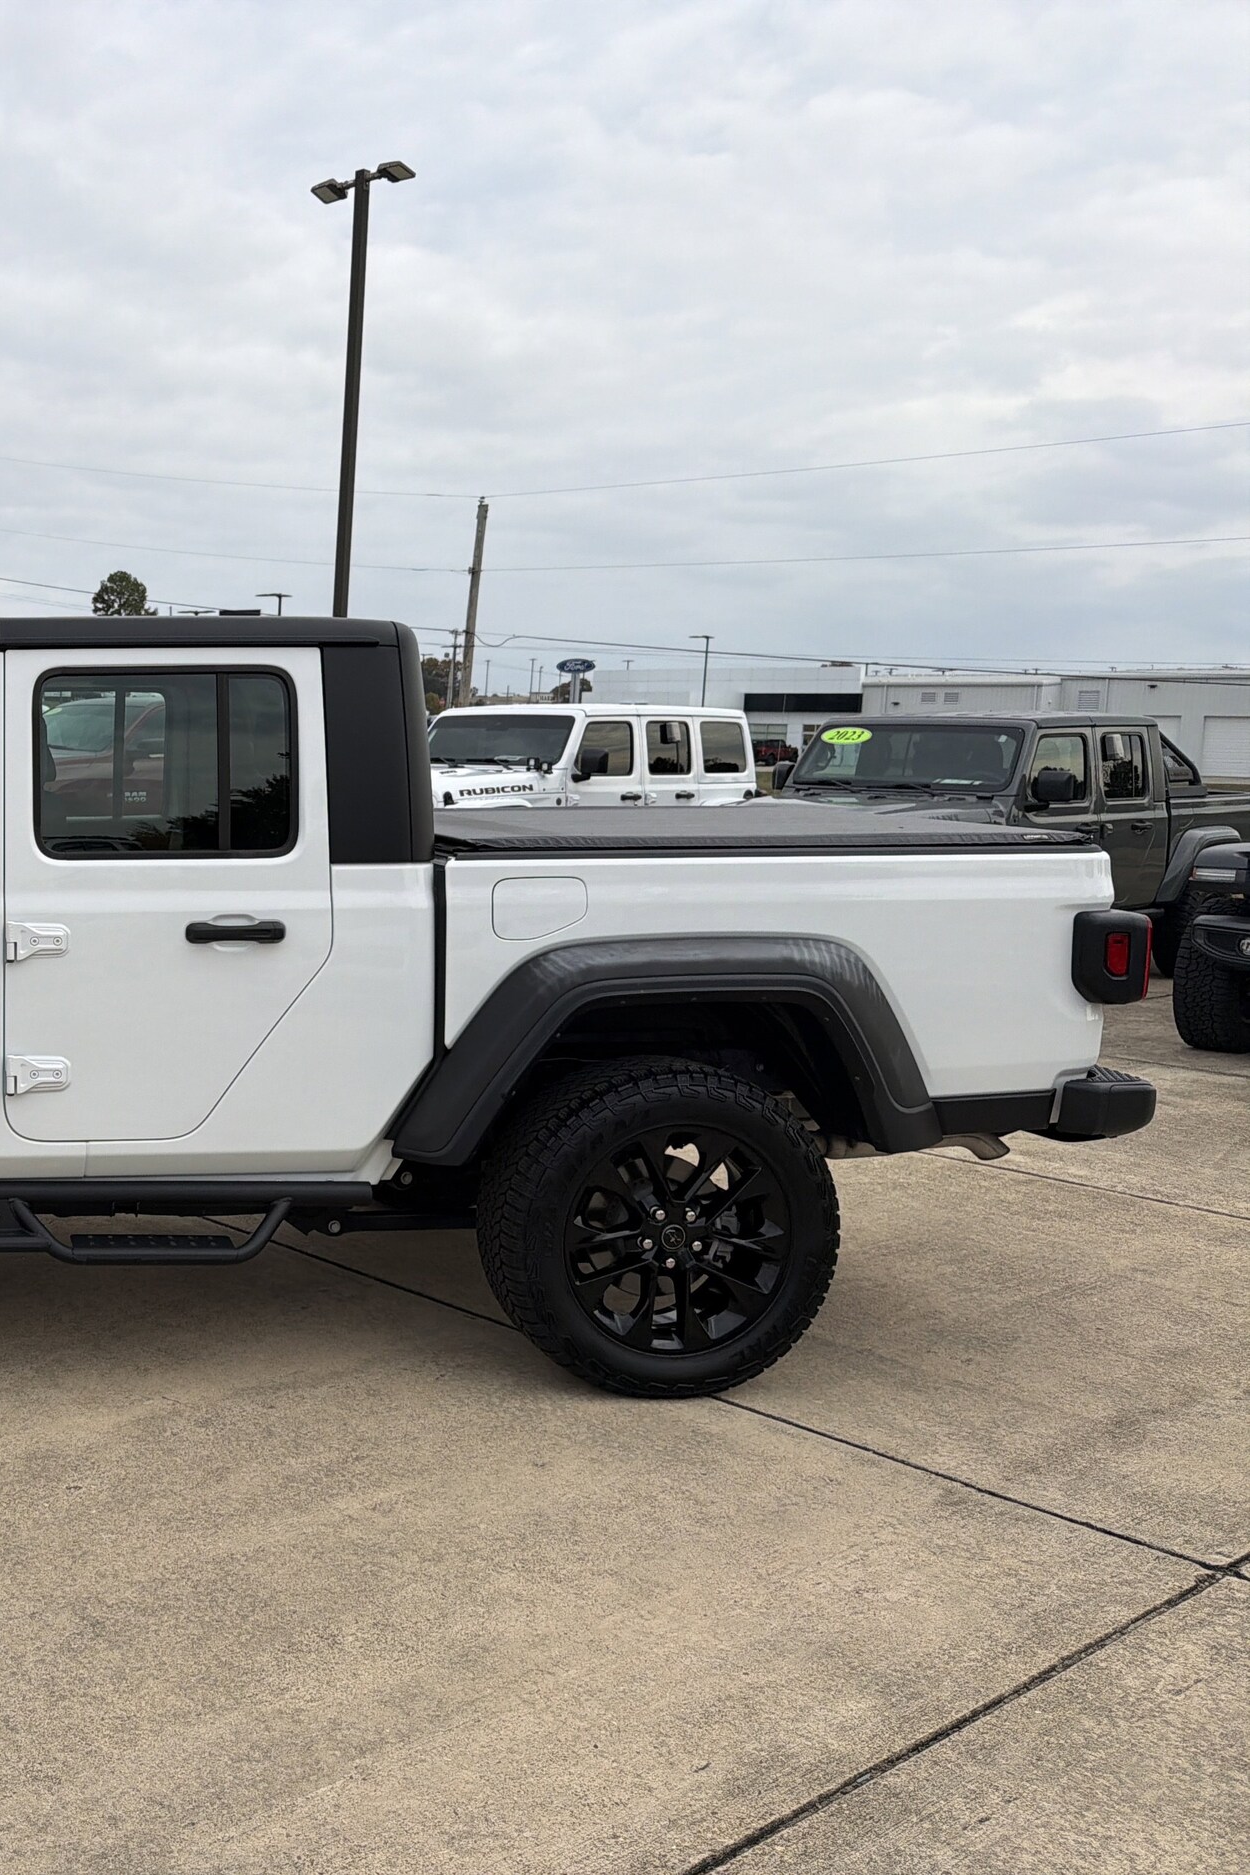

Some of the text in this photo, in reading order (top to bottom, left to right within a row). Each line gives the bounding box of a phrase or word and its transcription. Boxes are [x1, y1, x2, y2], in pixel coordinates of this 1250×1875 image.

[564, 660, 588, 671] Ford
[827, 730, 865, 741] 2023
[459, 784, 534, 797] RUBICON
